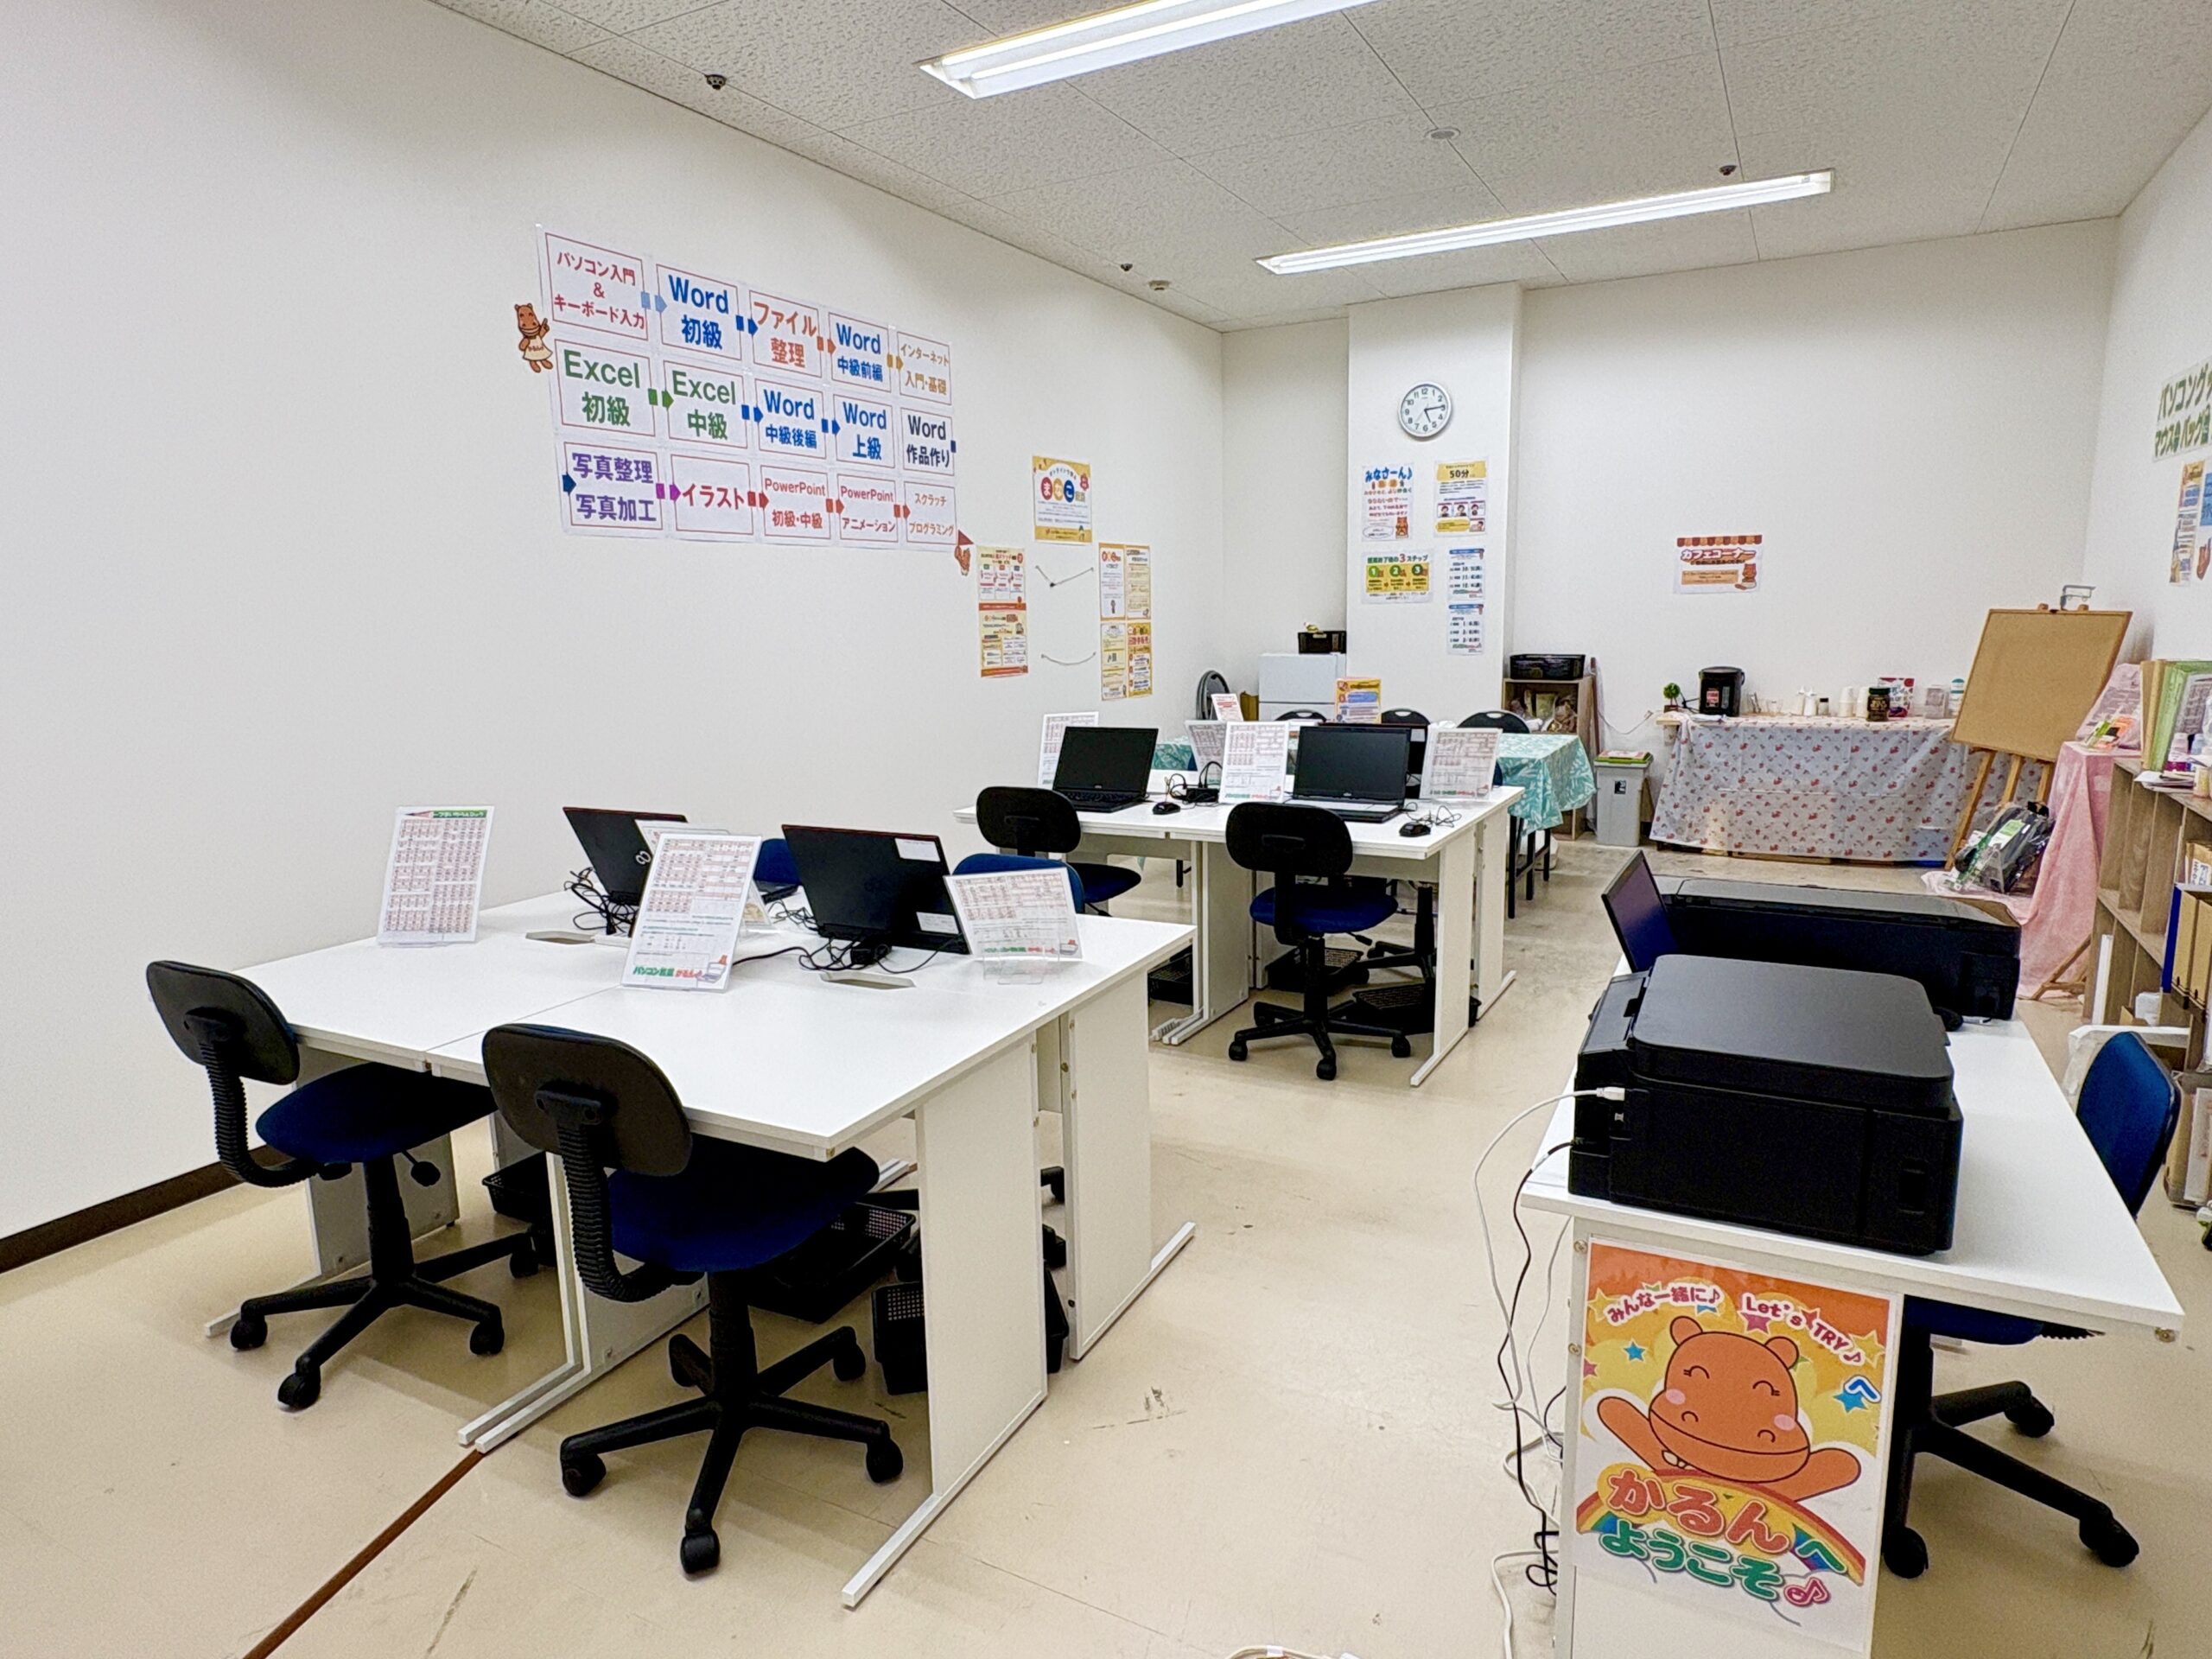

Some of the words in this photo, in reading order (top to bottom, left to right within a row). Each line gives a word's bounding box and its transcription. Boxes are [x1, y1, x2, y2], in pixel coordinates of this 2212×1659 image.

[594, 282, 605, 298] &
[668, 275, 729, 315] Word
[554, 294, 645, 330] キーボード入力
[753, 302, 817, 337] ファイル
[681, 315, 722, 350] 初級
[836, 323, 881, 354] Word
[770, 337, 805, 368] 整理
[900, 344, 949, 366] インターネット
[563, 349, 640, 388] Excel
[837, 356, 883, 382] 中級前編
[671, 370, 736, 404] Excel
[582, 391, 631, 427] 初級
[764, 390, 815, 420] Word
[842, 401, 887, 429] Word
[687, 409, 728, 440] 中級
[765, 424, 817, 449] 中級後編
[907, 415, 946, 440] Word
[852, 434, 881, 461] 上級
[906, 444, 950, 467] 作品作り
[572, 453, 653, 484] 写真整理
[683, 483, 745, 510] イラスト
[764, 478, 825, 496] PowerPoint
[840, 486, 893, 502] PowerPoint
[915, 493, 946, 506] スクラッチ
[575, 493, 656, 522] 写真加工
[842, 518, 895, 533] アニメーション
[909, 522, 954, 536] プログラミング
[1681, 548, 1756, 559] カフェコーナー
[1607, 1287, 1707, 1323] みんな一緒に
[1745, 1296, 1803, 1326] Let's
[1813, 1322, 1849, 1351] TRY
[1602, 1521, 1783, 1599] ようこそ
